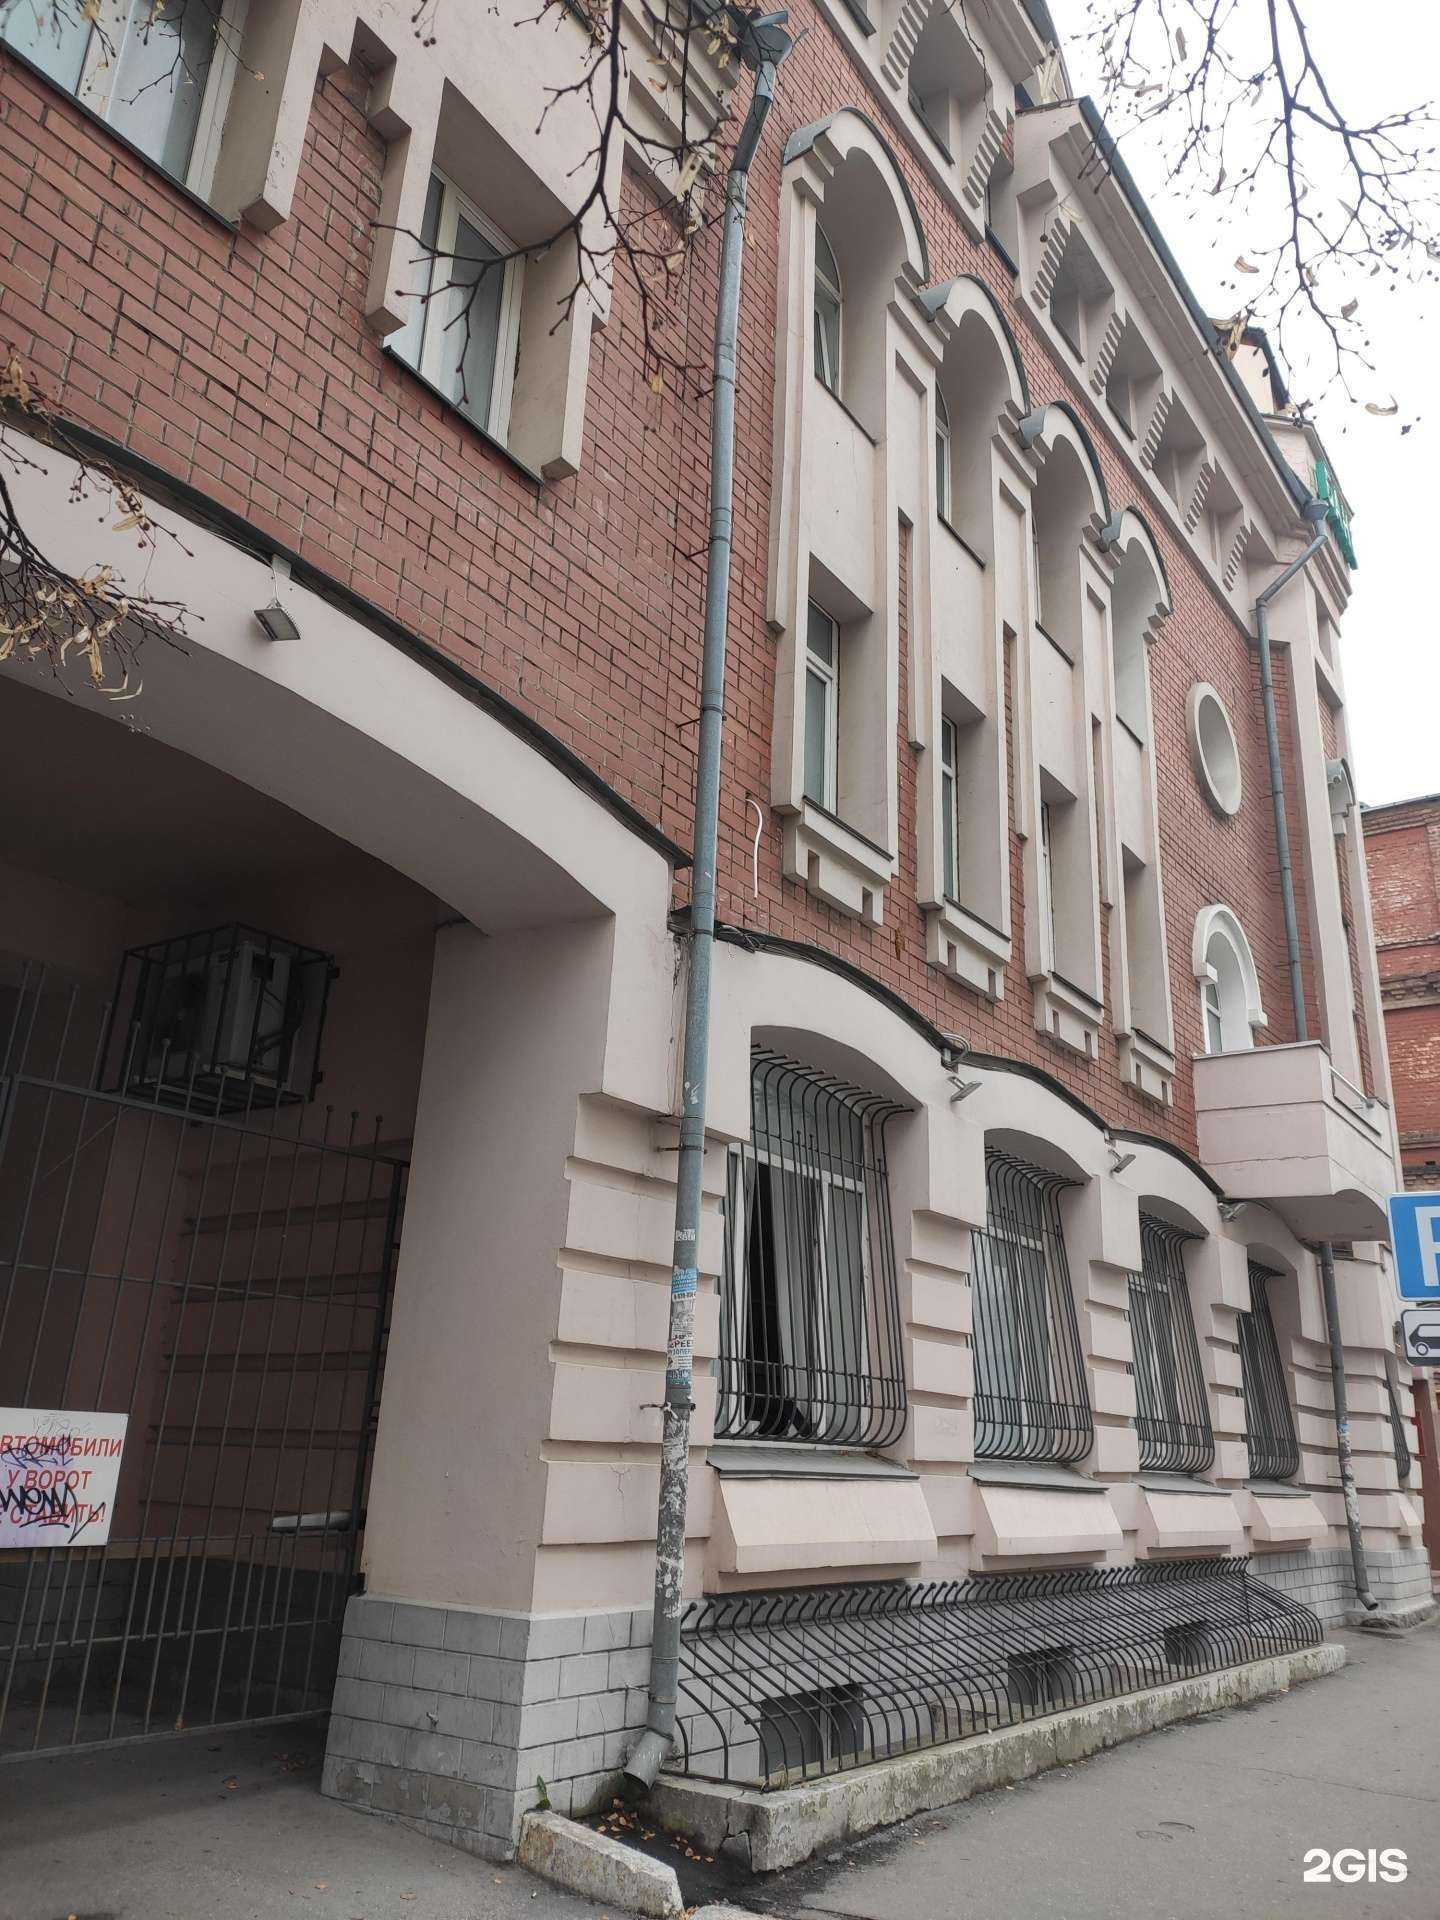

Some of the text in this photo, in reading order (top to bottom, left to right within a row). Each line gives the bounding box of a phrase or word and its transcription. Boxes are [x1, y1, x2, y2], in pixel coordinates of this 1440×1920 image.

[0, 1435, 122, 1457] ВТОМОБИЛИ
[8, 1470, 93, 1490] У ВОРОТ
